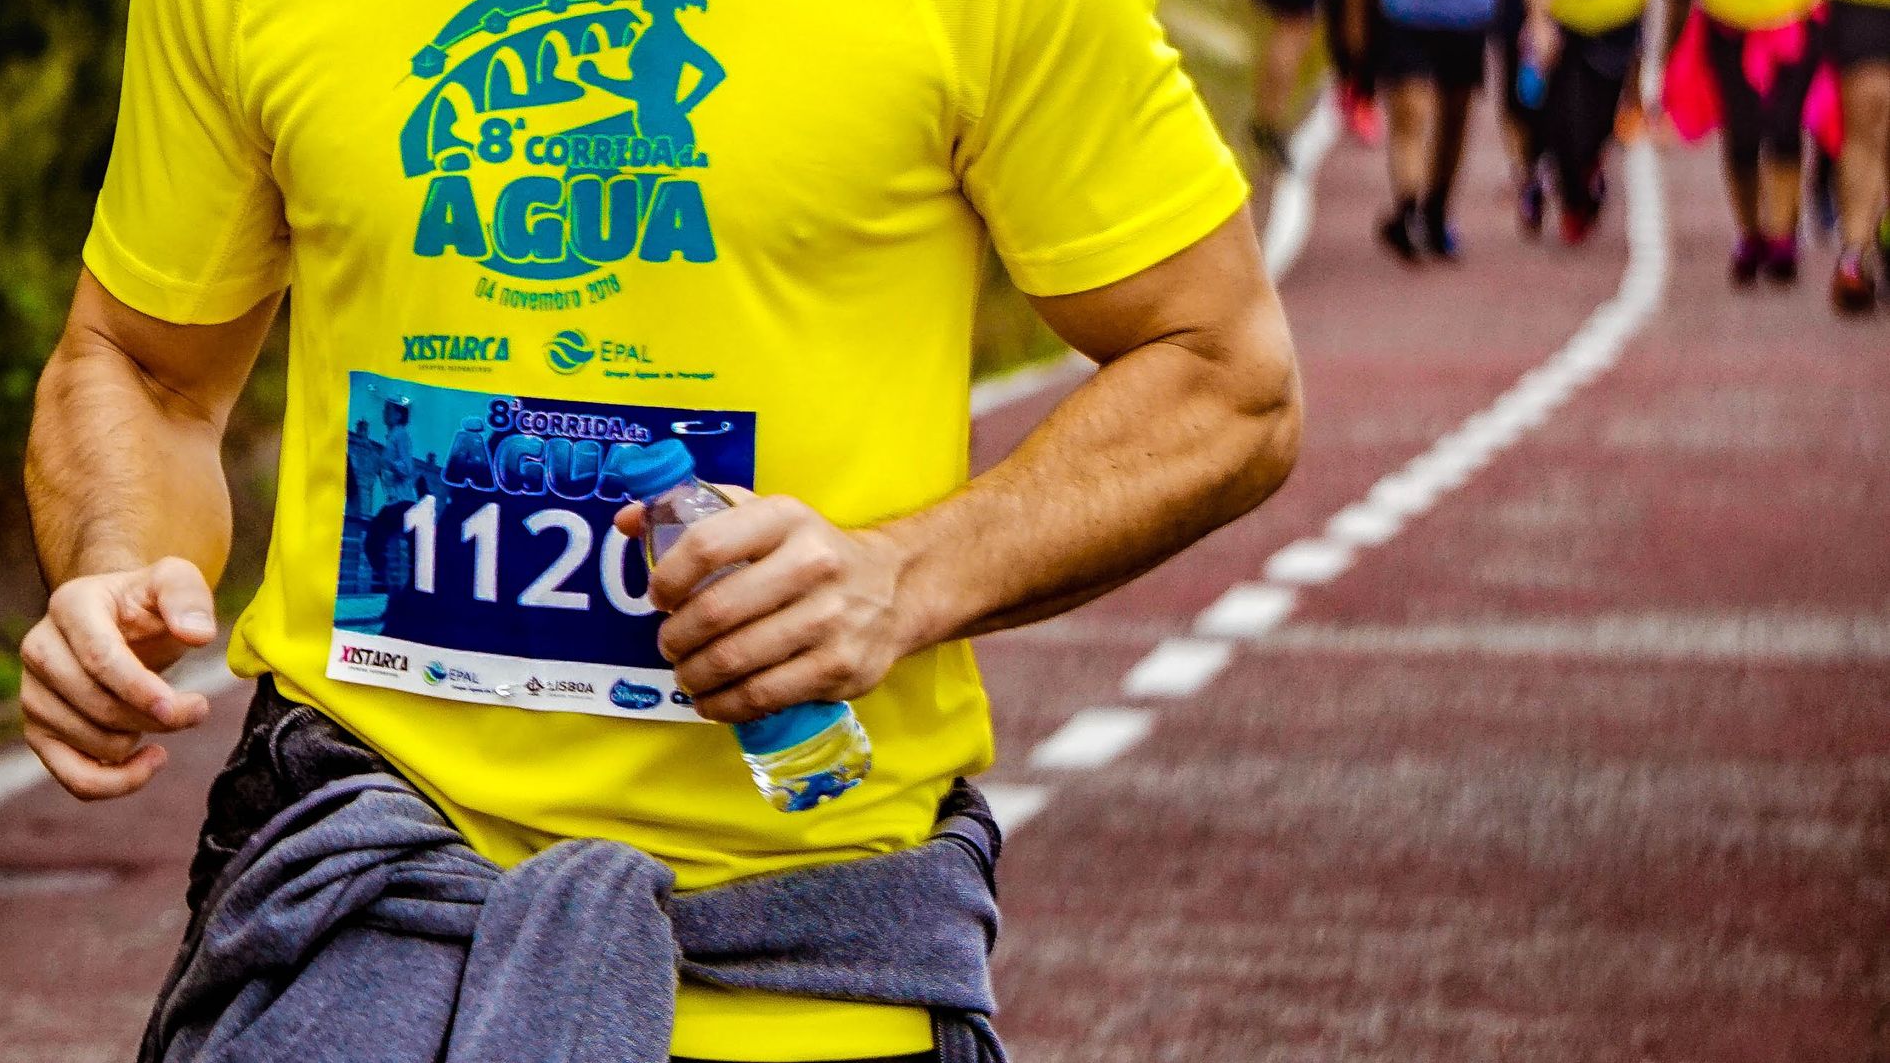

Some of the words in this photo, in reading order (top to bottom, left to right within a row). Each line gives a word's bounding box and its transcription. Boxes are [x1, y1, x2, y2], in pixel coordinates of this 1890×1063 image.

[524, 135, 677, 168] CORRIDA
[413, 151, 718, 264] ÁGUA
[401, 334, 509, 363] XISTARCA
[600, 340, 653, 364] EPAL
[515, 409, 626, 440] CORRIDA
[341, 645, 408, 672] XISTARCA
[450, 668, 480, 685] EPAL
[548, 680, 595, 694] LISBOA
